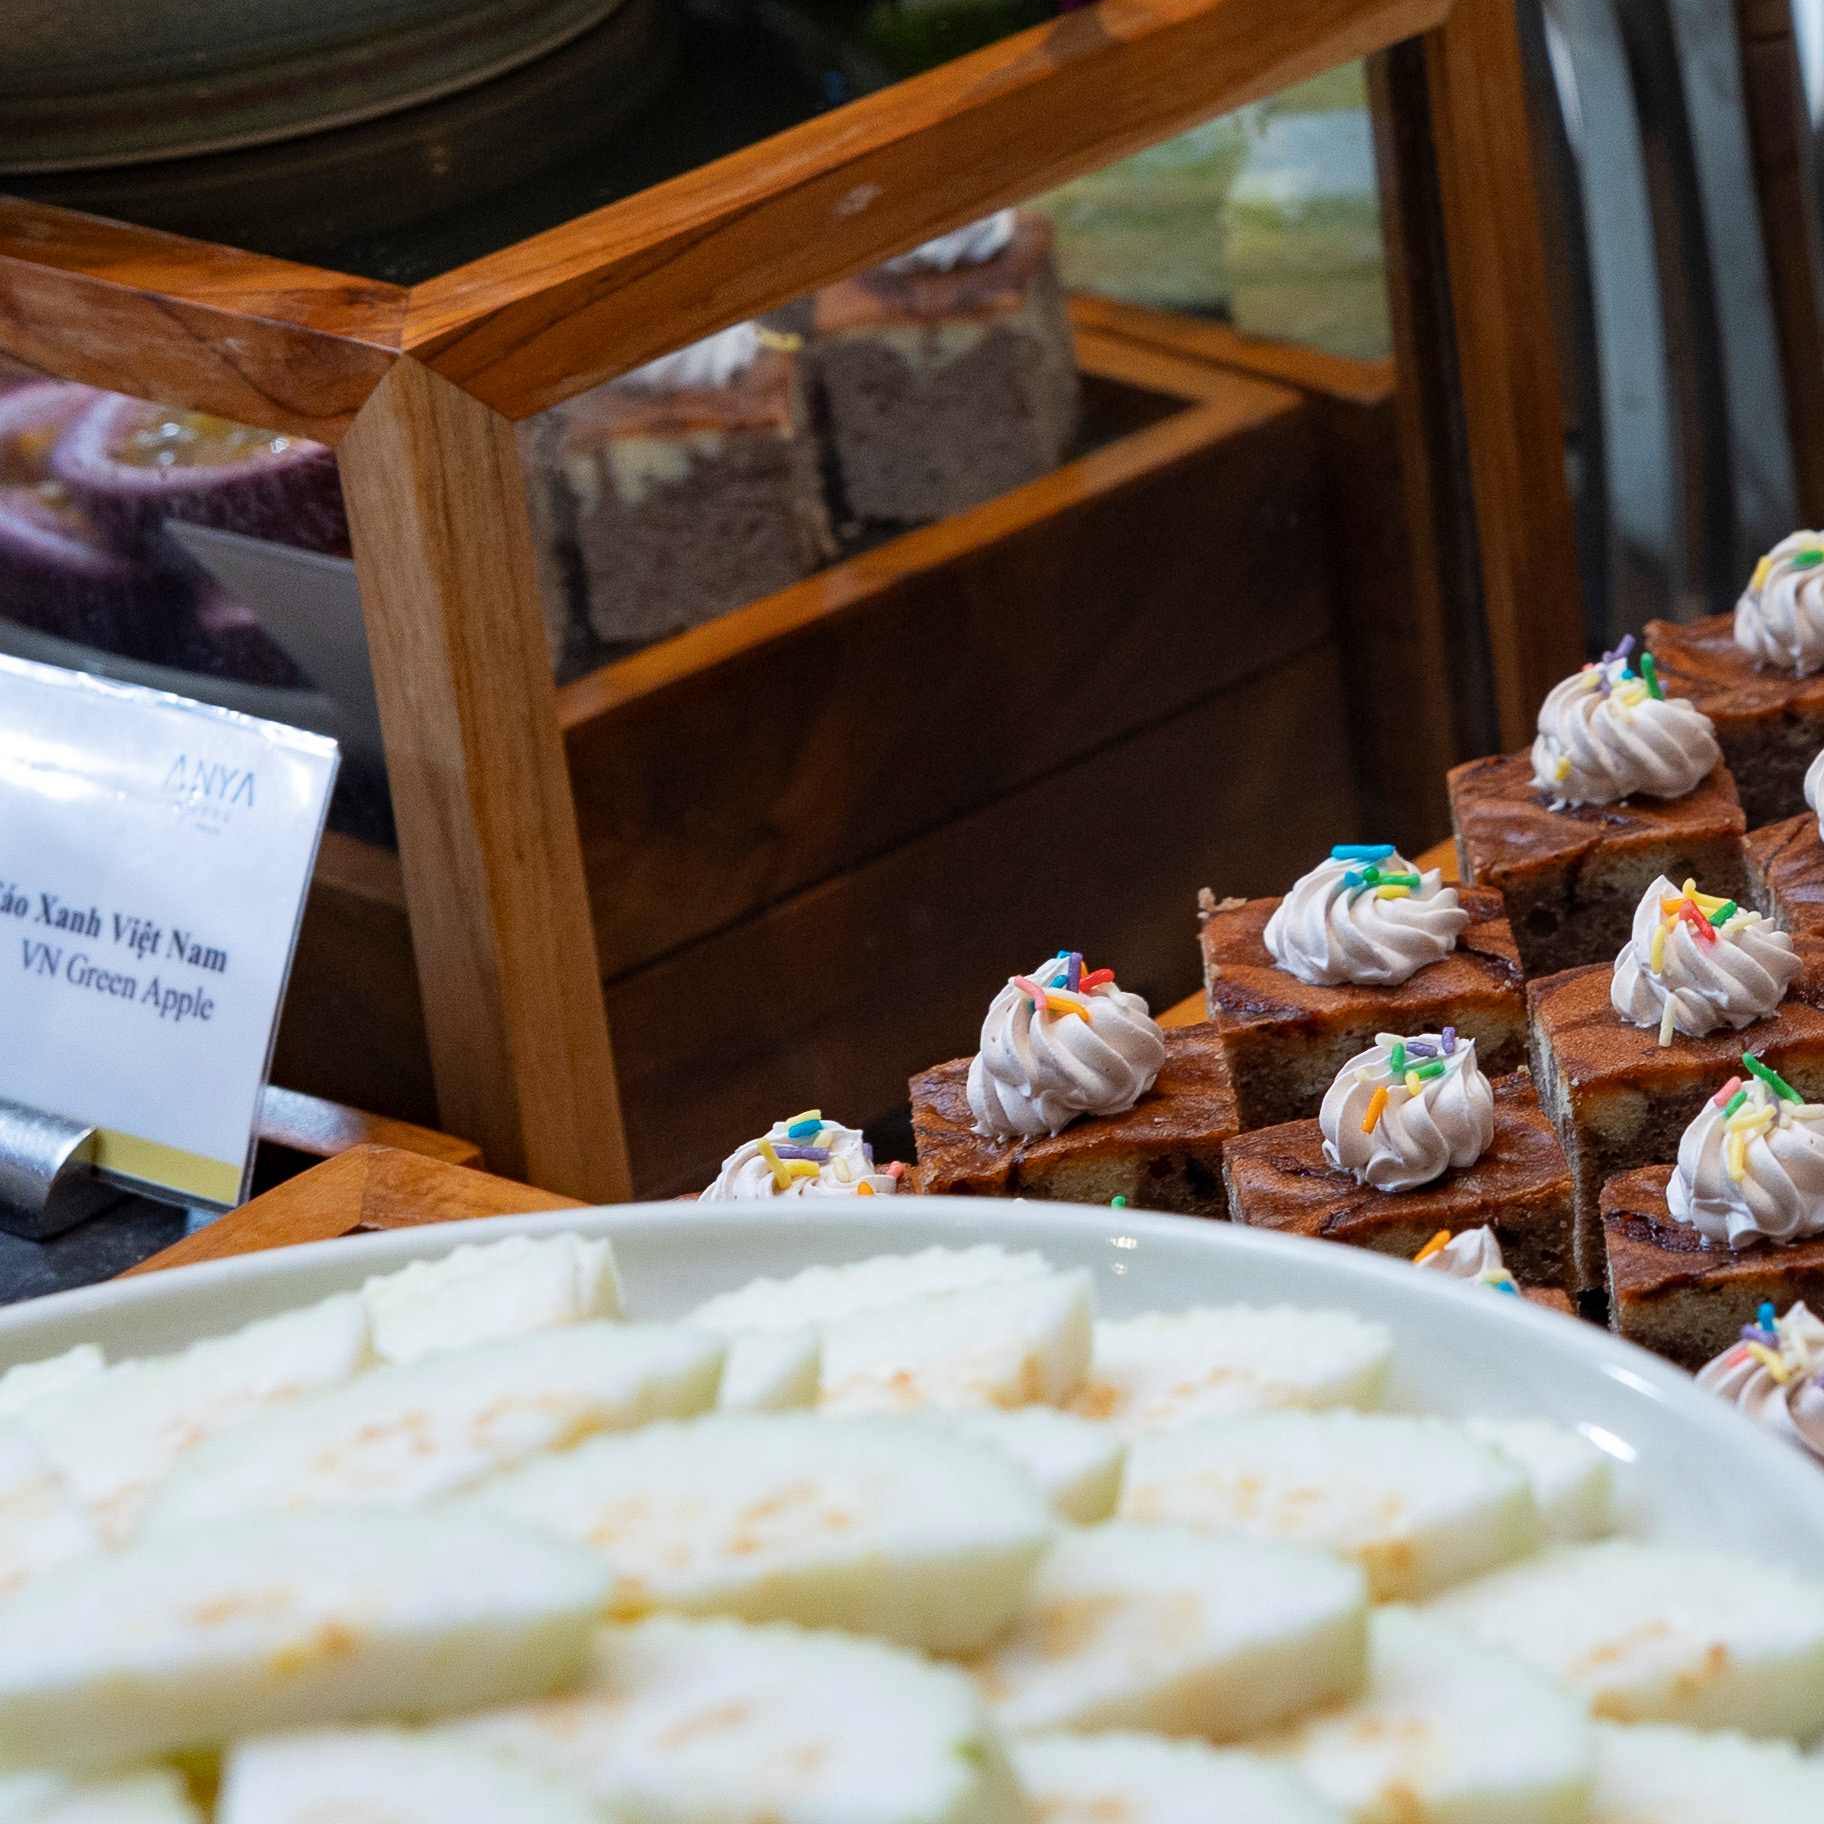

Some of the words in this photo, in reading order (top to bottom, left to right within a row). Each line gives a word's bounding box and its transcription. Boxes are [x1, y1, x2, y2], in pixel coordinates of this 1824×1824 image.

[164, 753, 255, 808] ANYA
[34, 892, 102, 937] Xanh
[112, 910, 163, 961] Việt
[167, 930, 229, 974] Nam
[21, 939, 63, 978] VN
[66, 953, 138, 1001] Green
[141, 979, 215, 1022] Apple
